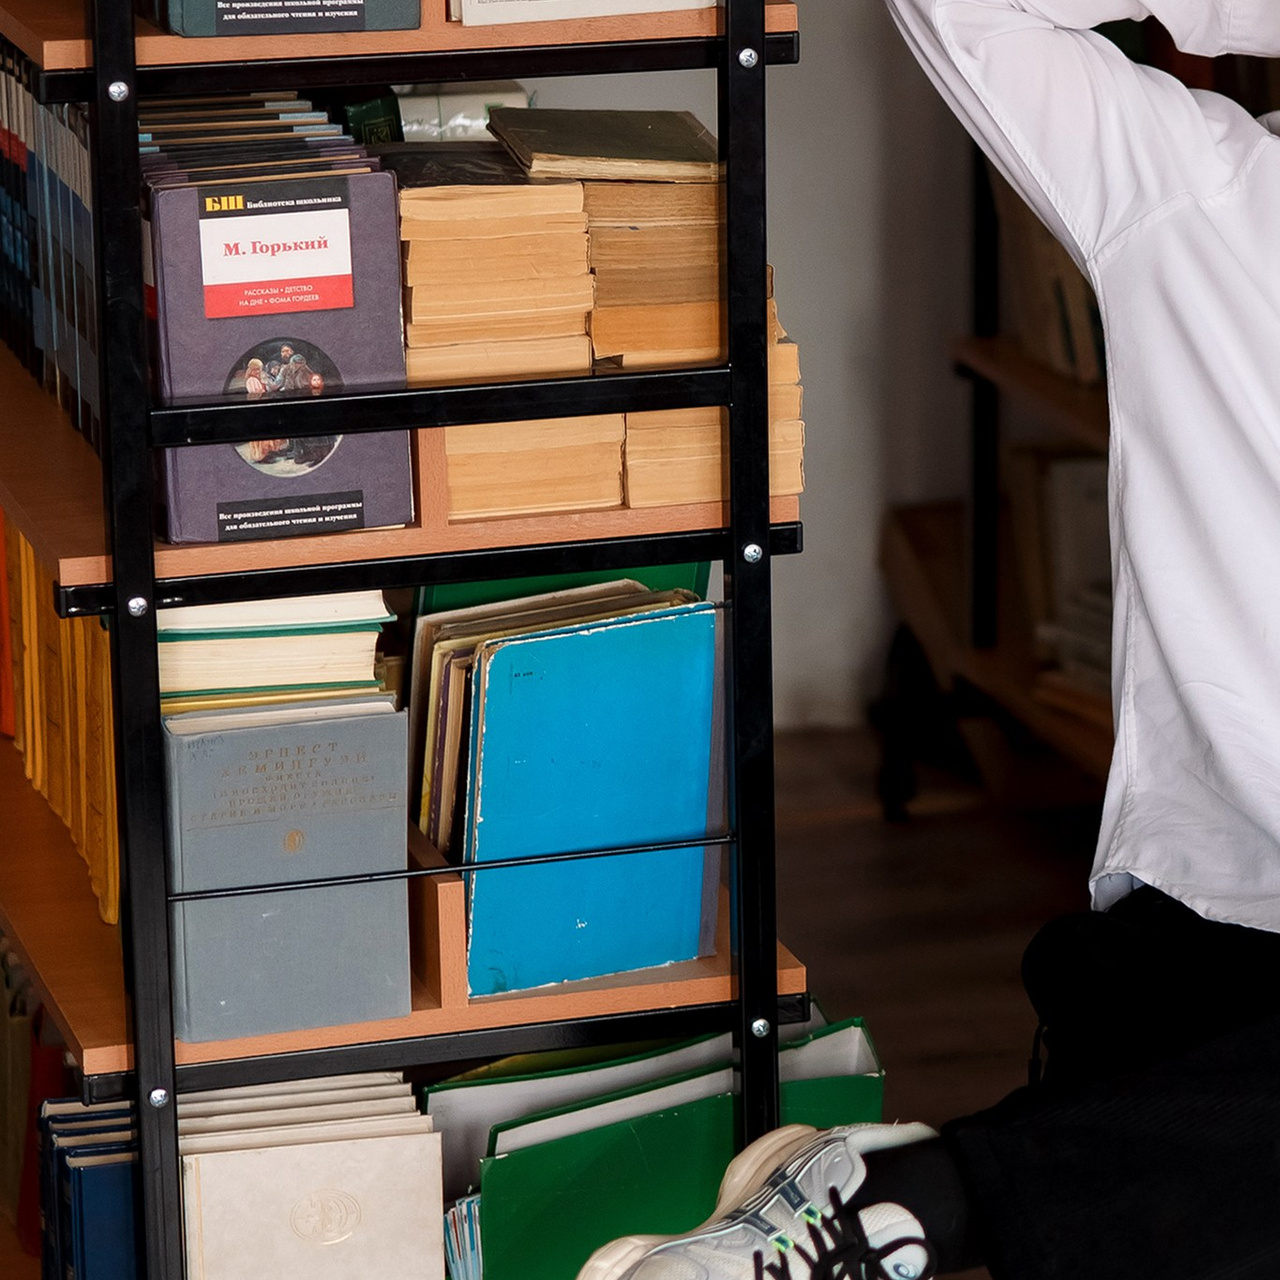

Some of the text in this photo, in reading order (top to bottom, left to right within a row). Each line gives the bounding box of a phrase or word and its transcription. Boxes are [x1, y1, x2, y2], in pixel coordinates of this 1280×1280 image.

[232, 0, 282, 9] произведения
[222, 13, 236, 21] для
[237, 11, 289, 20] обязательного
[324, 10, 358, 18] изучения
[205, 195, 342, 212] БШ Библиотека школьника
[223, 235, 329, 257] М. Горький
[244, 285, 313, 296] РАССКАЗЫ ДЕТСТВО
[269, 297, 291, 305] ФОМА
[292, 294, 319, 302] ГОРДЕЕВ
[233, 509, 283, 520] произведения
[284, 505, 321, 515] школьной
[322, 501, 363, 512] программы
[225, 524, 238, 532] для
[238, 519, 290, 530] обязательного
[324, 513, 357, 523] изучения
[249, 742, 338, 760] ЭРНЕСТ
[221, 752, 366, 778] ХЕМИНГУЭЙ
